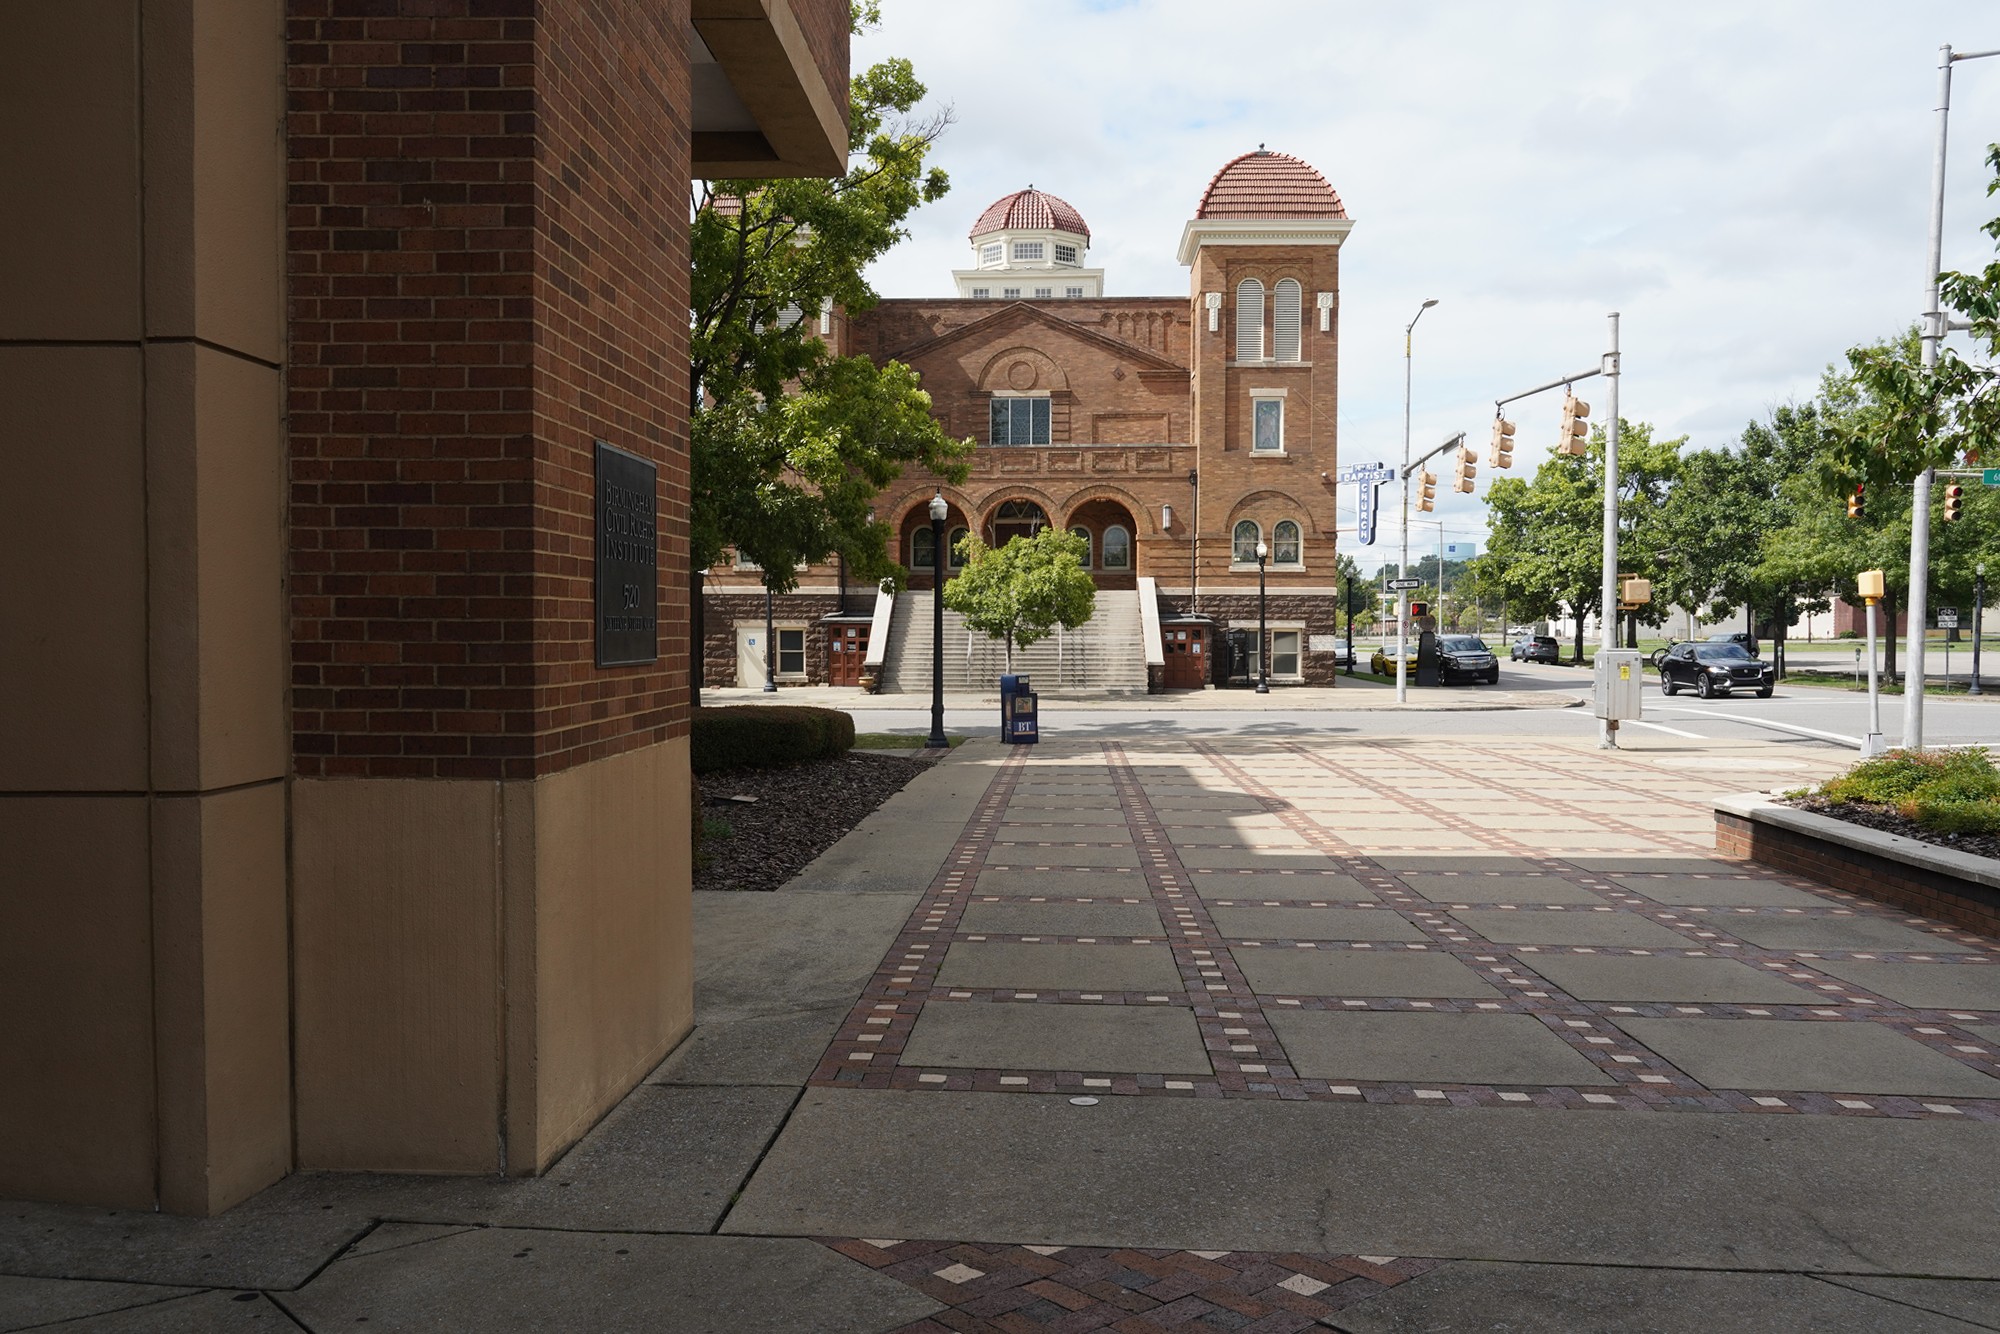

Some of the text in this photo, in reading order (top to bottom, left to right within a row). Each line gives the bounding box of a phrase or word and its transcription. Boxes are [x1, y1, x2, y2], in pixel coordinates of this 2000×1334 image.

[1344, 470, 1387, 482] BAPTIST
[606, 479, 655, 516] BIRMINGHAM
[1360, 483, 1368, 539] CHURCH
[605, 507, 655, 541] CIVIL RIGHTS
[606, 534, 654, 566] INSTITUTE
[623, 583, 640, 610] 520
[1018, 721, 1031, 732] BT
